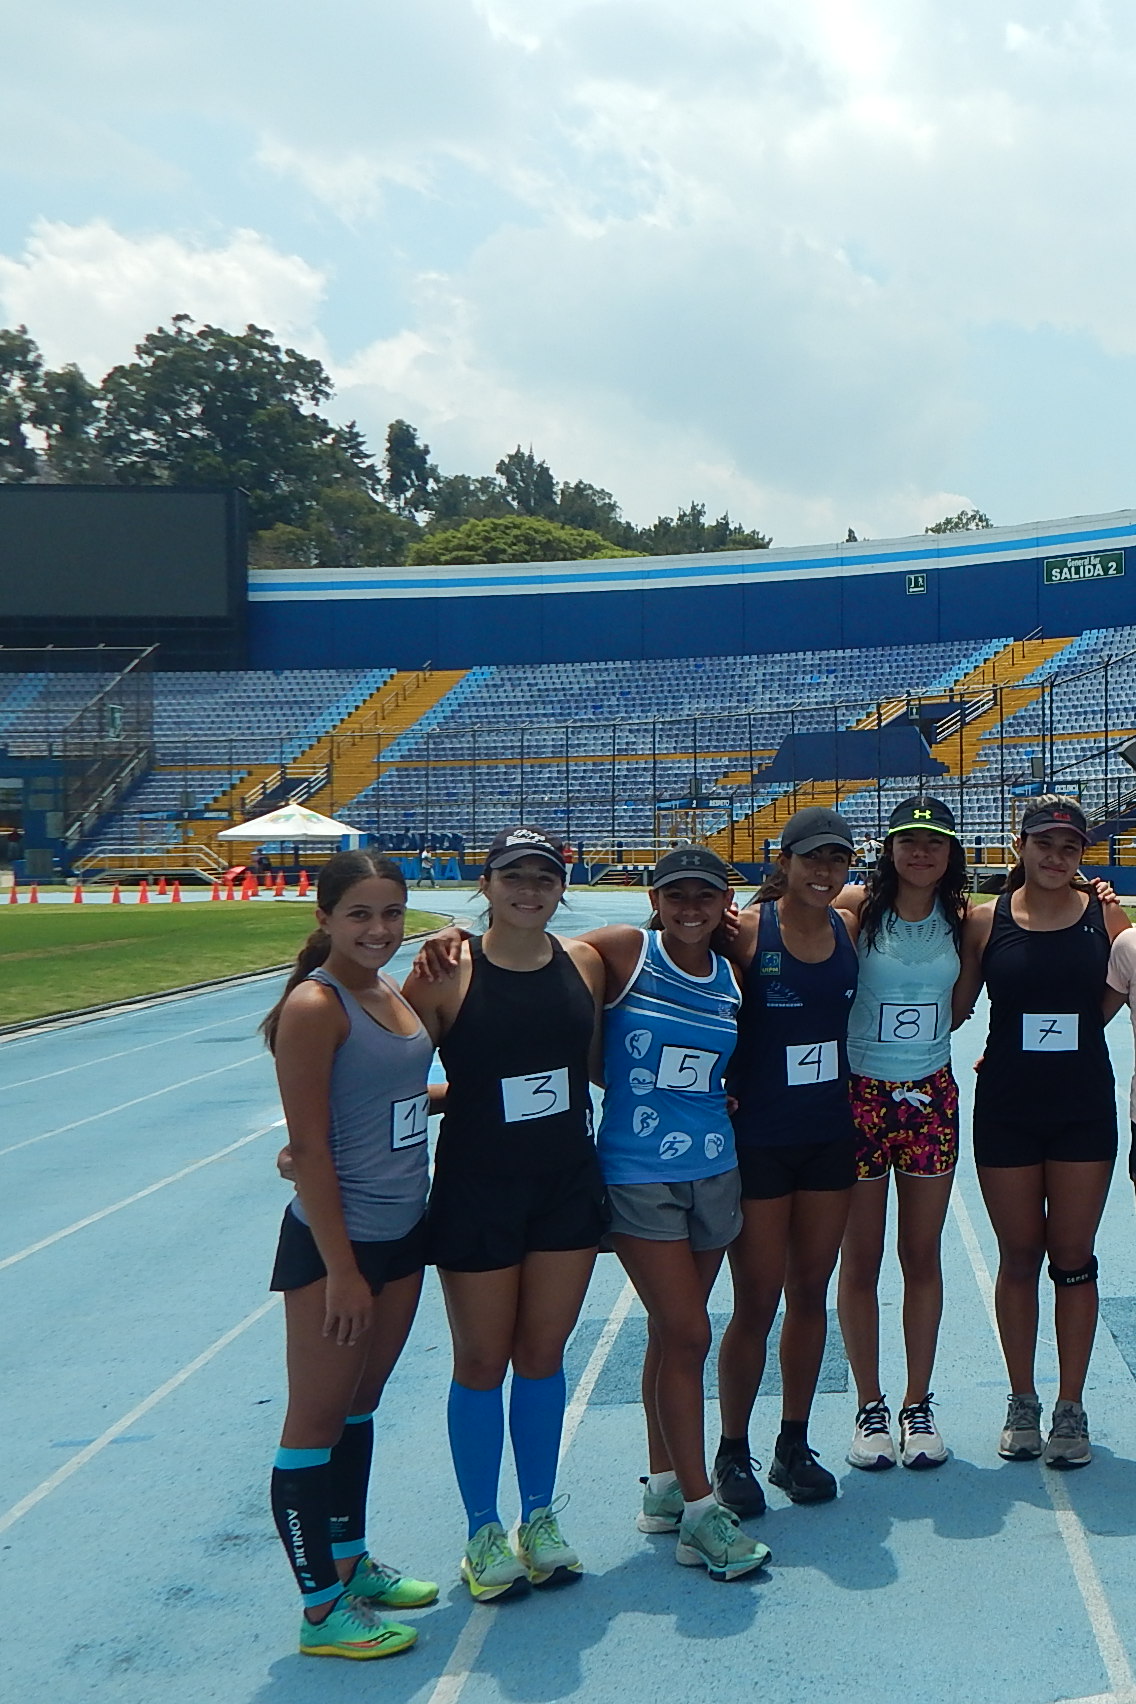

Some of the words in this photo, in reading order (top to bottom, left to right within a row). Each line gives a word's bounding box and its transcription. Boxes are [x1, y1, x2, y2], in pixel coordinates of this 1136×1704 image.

[1051, 564, 1104, 580] SALIDA
[1108, 562, 1117, 575] 2
[1067, 556, 1089, 567] General
[893, 1008, 921, 1040] 8
[1039, 1020, 1063, 1044] 7
[667, 1054, 700, 1089] 5
[798, 1045, 823, 1081] 4
[522, 1075, 557, 1117] 3
